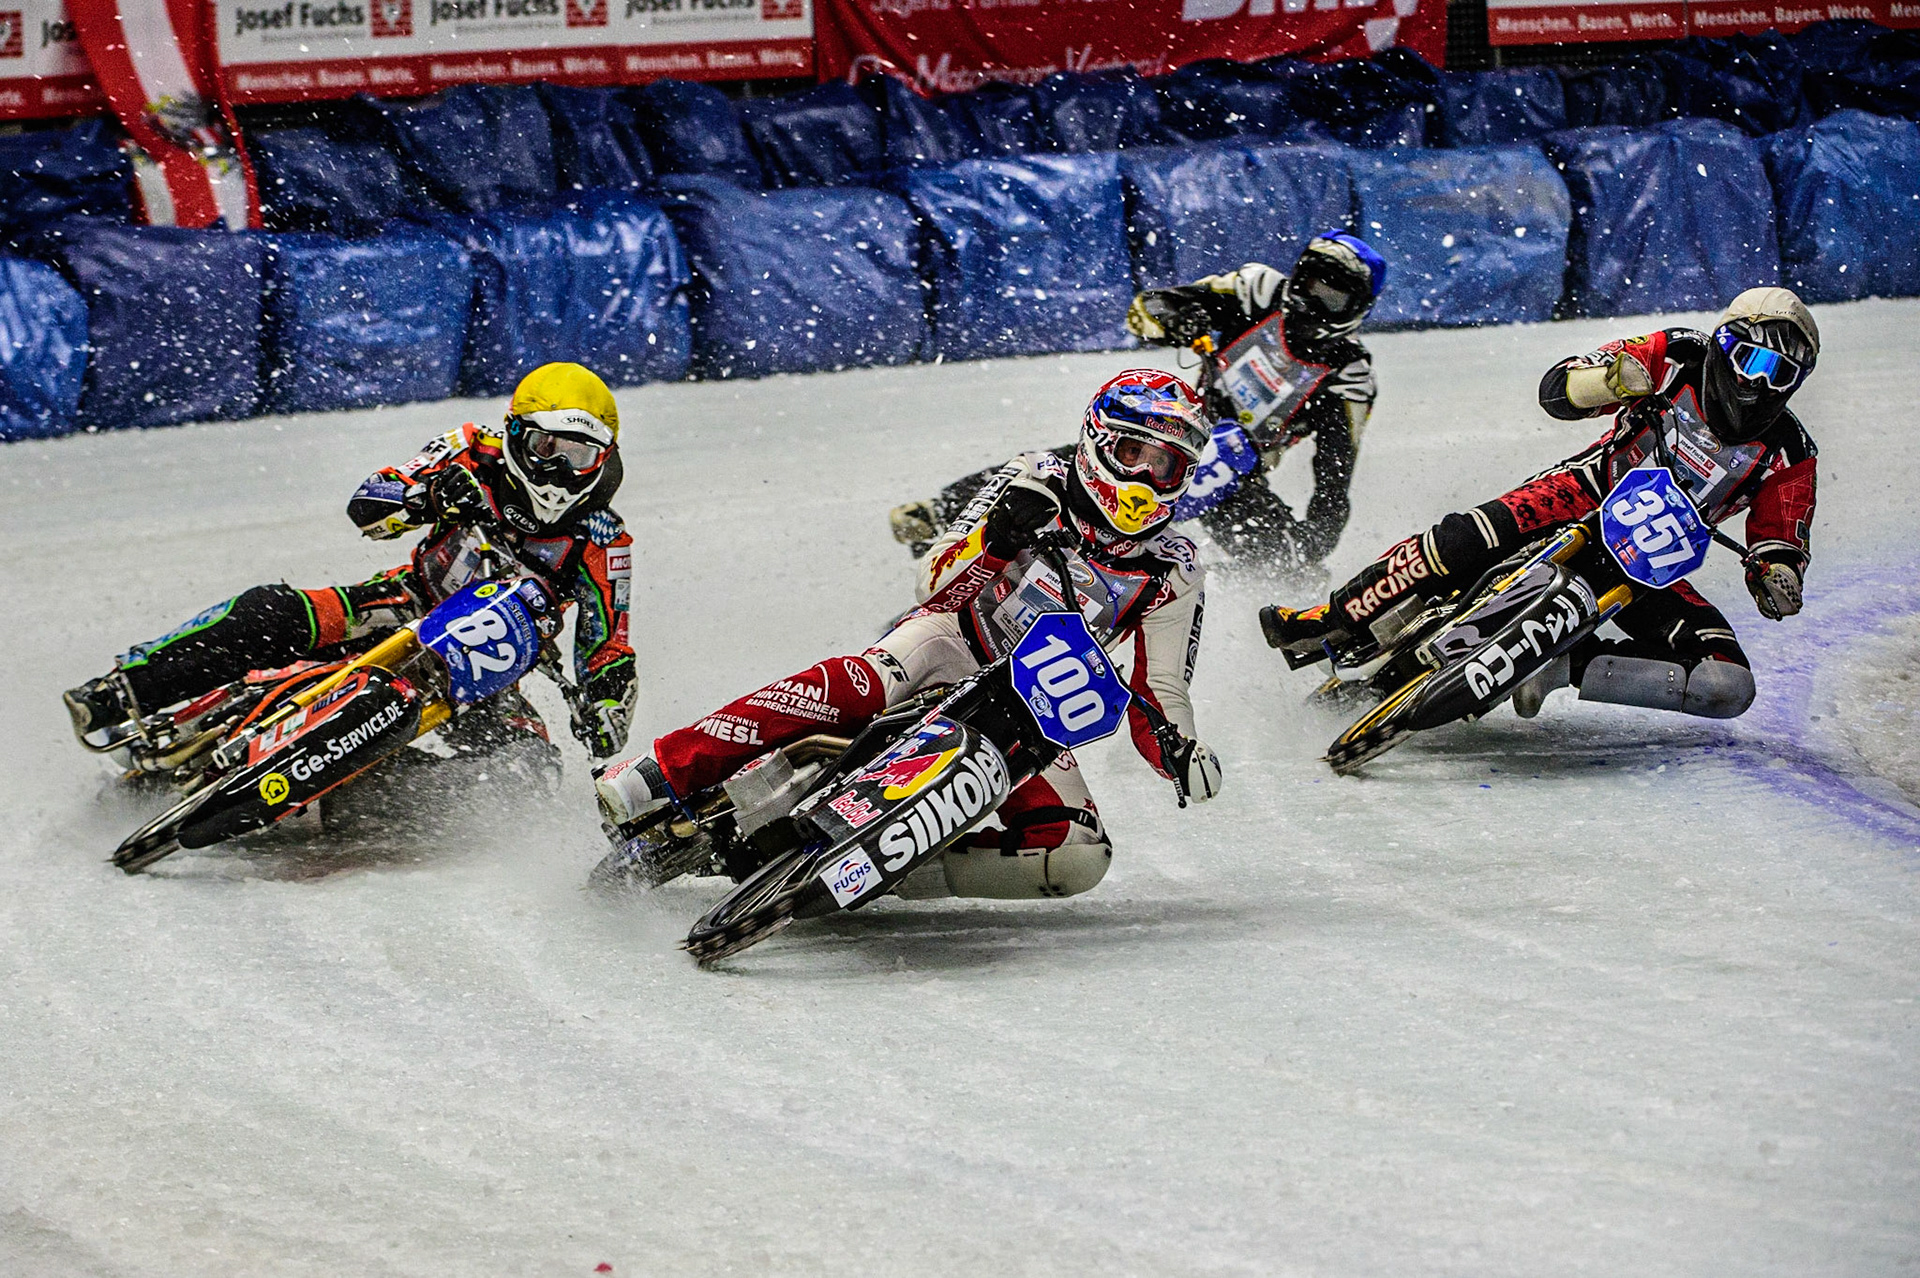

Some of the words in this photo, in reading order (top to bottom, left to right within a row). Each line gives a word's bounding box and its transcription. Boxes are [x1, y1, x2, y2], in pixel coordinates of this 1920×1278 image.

[566, 416, 595, 430] SHOEI
[1146, 415, 1165, 433] Red
[1166, 426, 1185, 440] Bull
[1611, 489, 1696, 570] 357
[1154, 534, 1196, 573] FUCHS
[1387, 538, 1419, 575] ICE
[1344, 557, 1430, 622] RACING
[444, 608, 517, 681] 82
[775, 680, 823, 702] MAN
[1019, 634, 1105, 732] 100
[744, 698, 765, 708] BAD
[753, 690, 841, 717] HINTSTEINER
[693, 718, 764, 746] MIESL
[828, 789, 860, 818] Red
[845, 796, 884, 829] Bull
[833, 862, 872, 894] FUCHS
